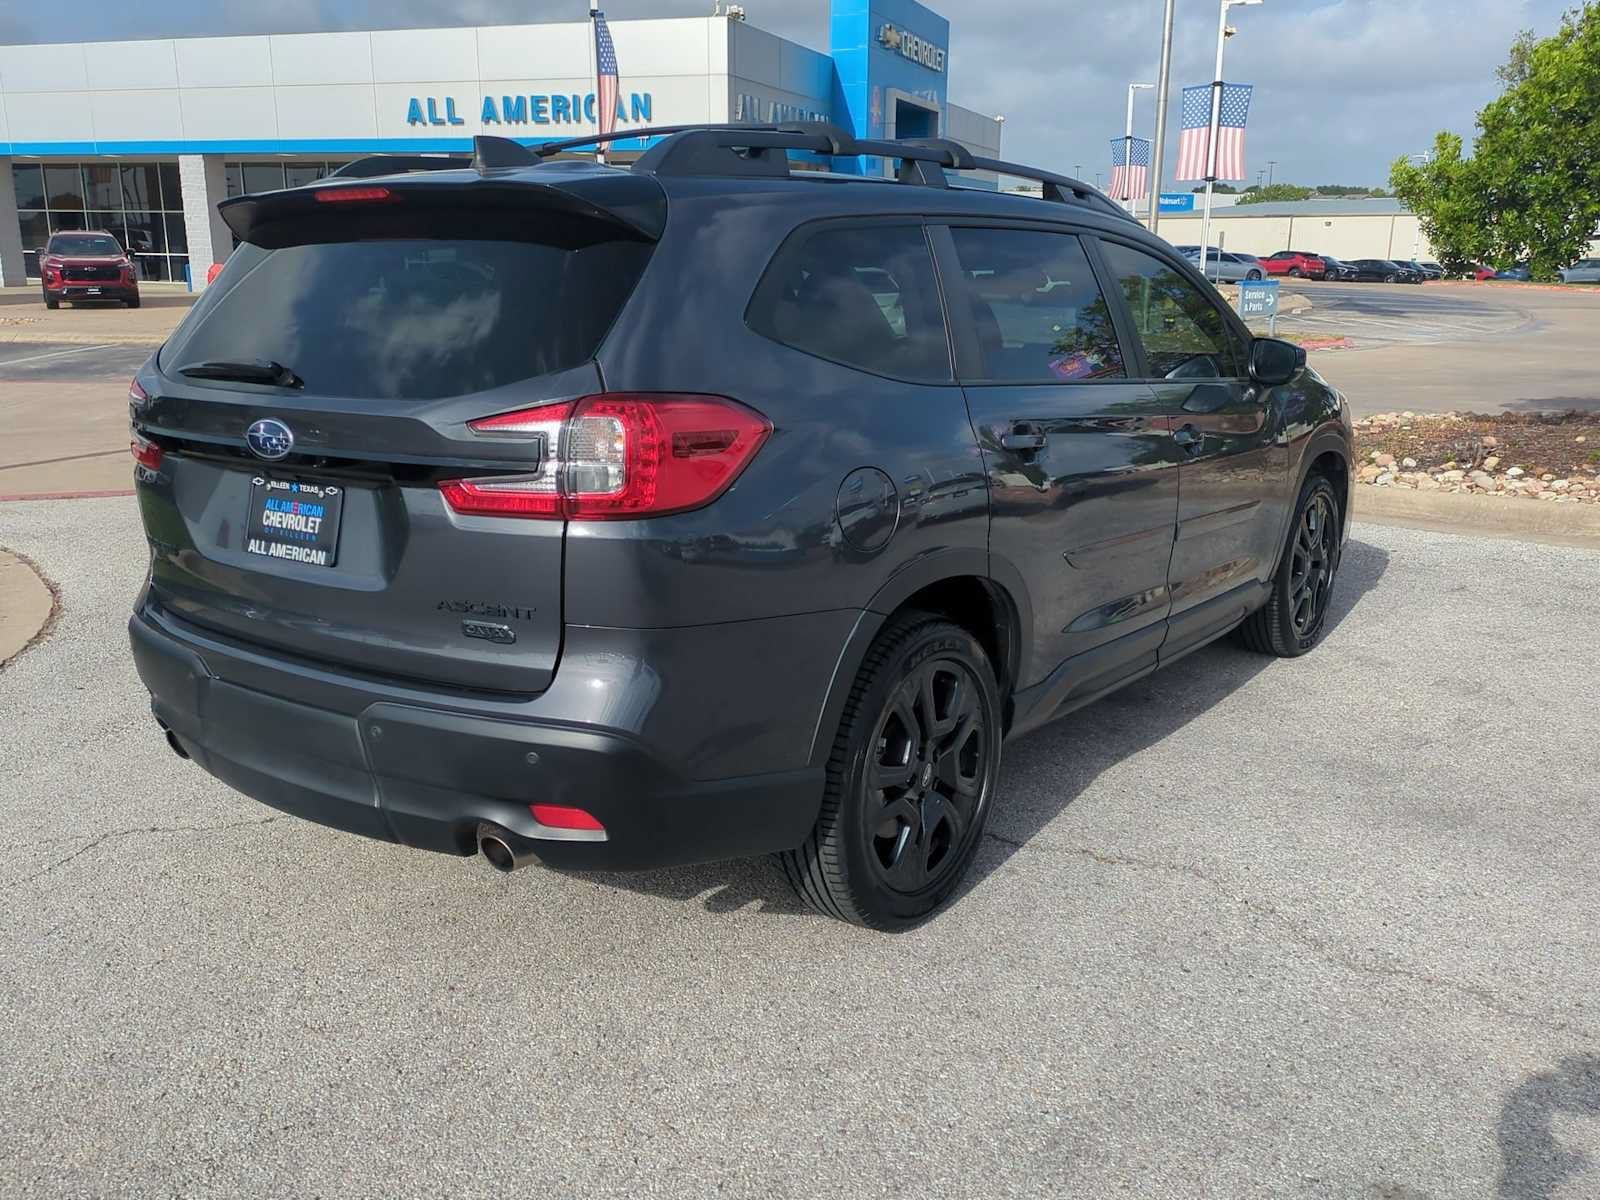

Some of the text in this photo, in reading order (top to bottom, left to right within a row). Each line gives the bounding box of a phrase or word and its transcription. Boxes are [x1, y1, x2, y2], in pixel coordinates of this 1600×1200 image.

[902, 31, 945, 73] CHEVROLET
[406, 97, 464, 126] ALL
[1245, 290, 1265, 299] Service
[1249, 302, 1263, 311] Parts
[300, 484, 319, 494] TEXAS
[265, 499, 324, 517] ALL AMERICAN
[262, 510, 322, 533] CHEVROLET
[248, 539, 326, 565] ALL AMERICAN
[437, 599, 536, 619] ASCENT
